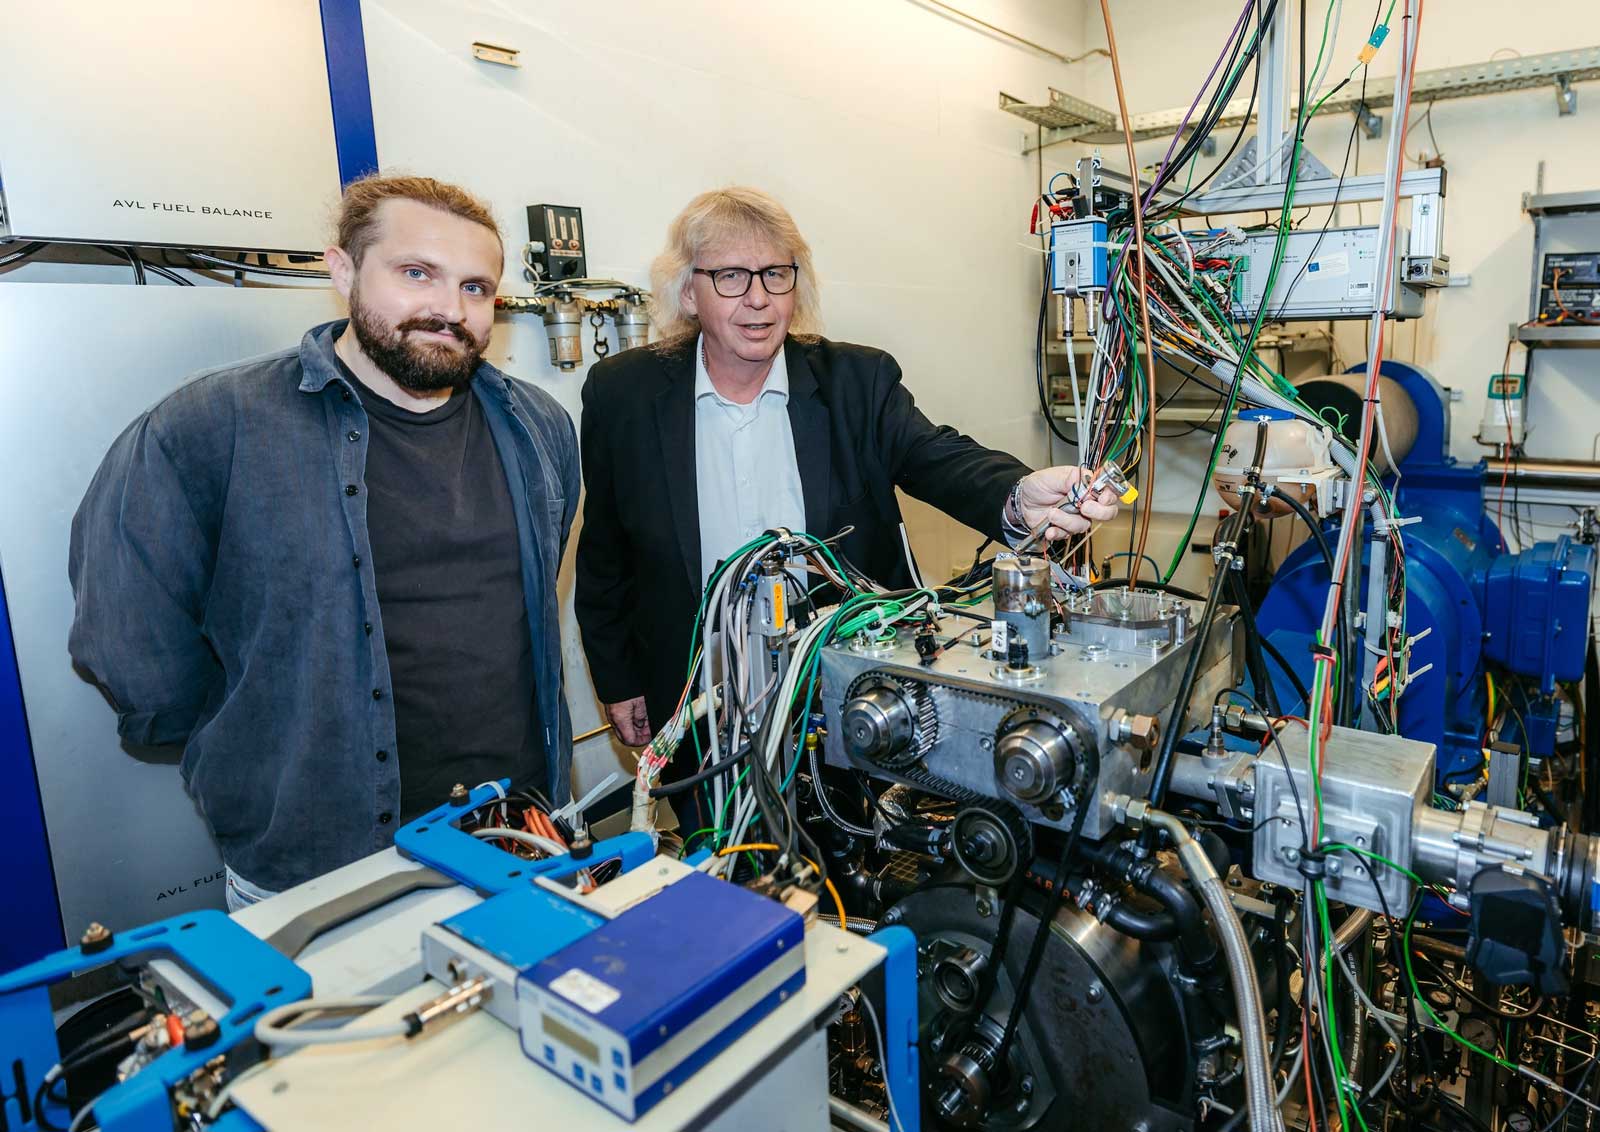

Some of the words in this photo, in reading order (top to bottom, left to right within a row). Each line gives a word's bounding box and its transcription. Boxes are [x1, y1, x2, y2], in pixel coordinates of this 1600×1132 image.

[113, 199, 145, 209] AVL
[152, 202, 195, 213] FUEL
[201, 206, 273, 219] BALANCE
[156, 886, 188, 901] AVL
[193, 870, 225, 888] FUE
